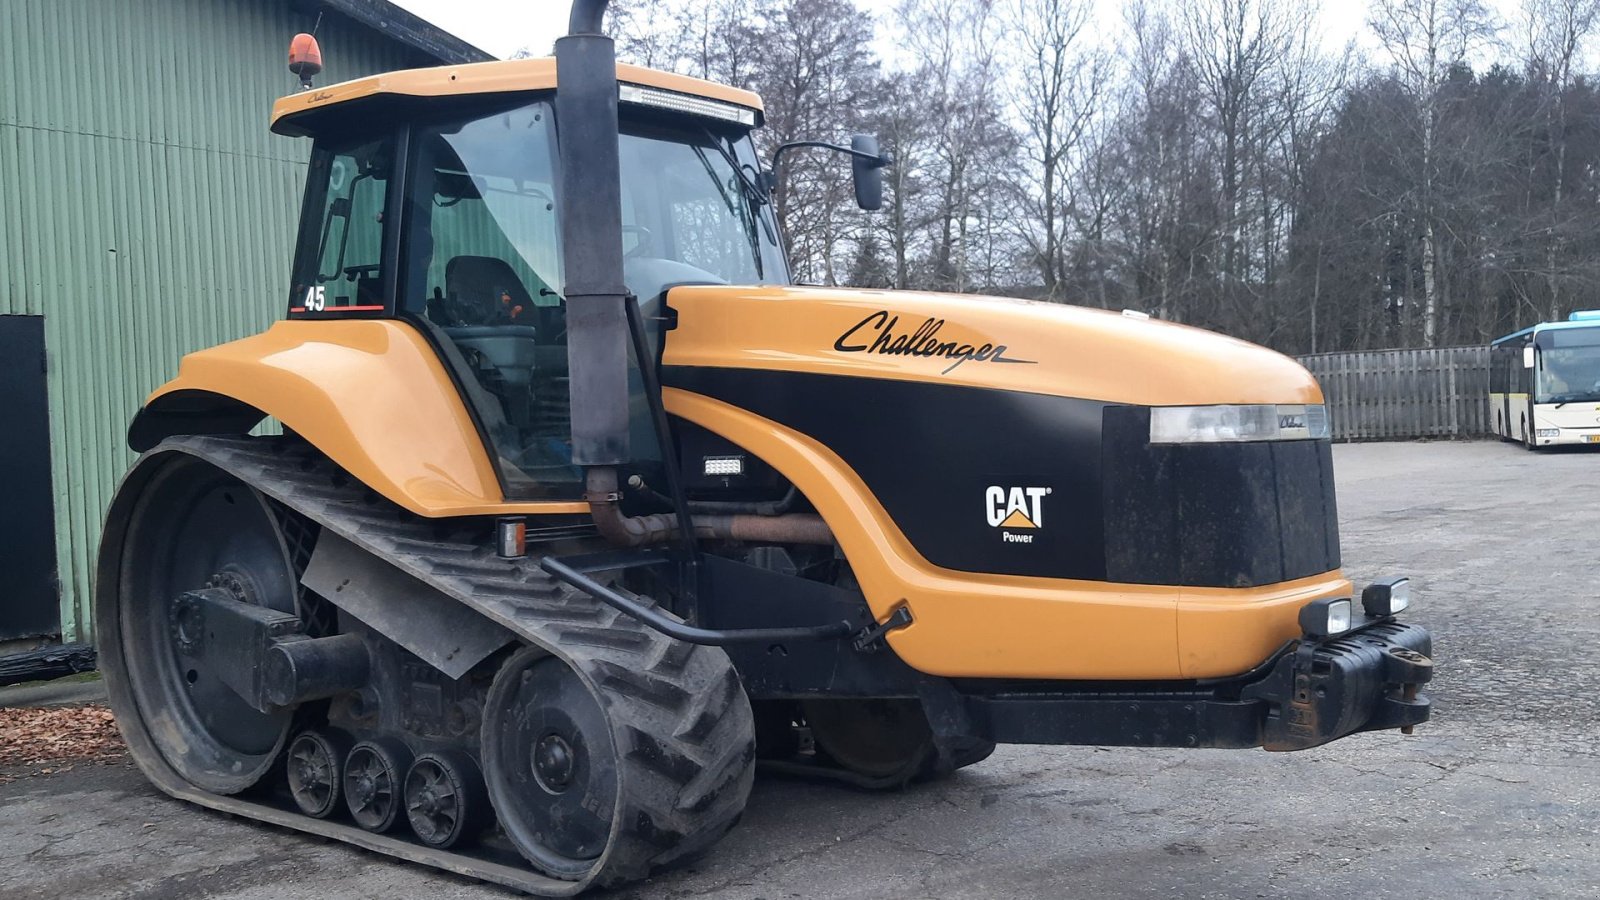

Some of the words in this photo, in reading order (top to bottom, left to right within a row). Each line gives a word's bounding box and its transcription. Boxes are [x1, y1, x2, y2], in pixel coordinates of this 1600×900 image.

[305, 286, 325, 311] 45
[834, 310, 1039, 375] Challenger
[985, 485, 1046, 528] CAT
[1003, 531, 1033, 543] Power
